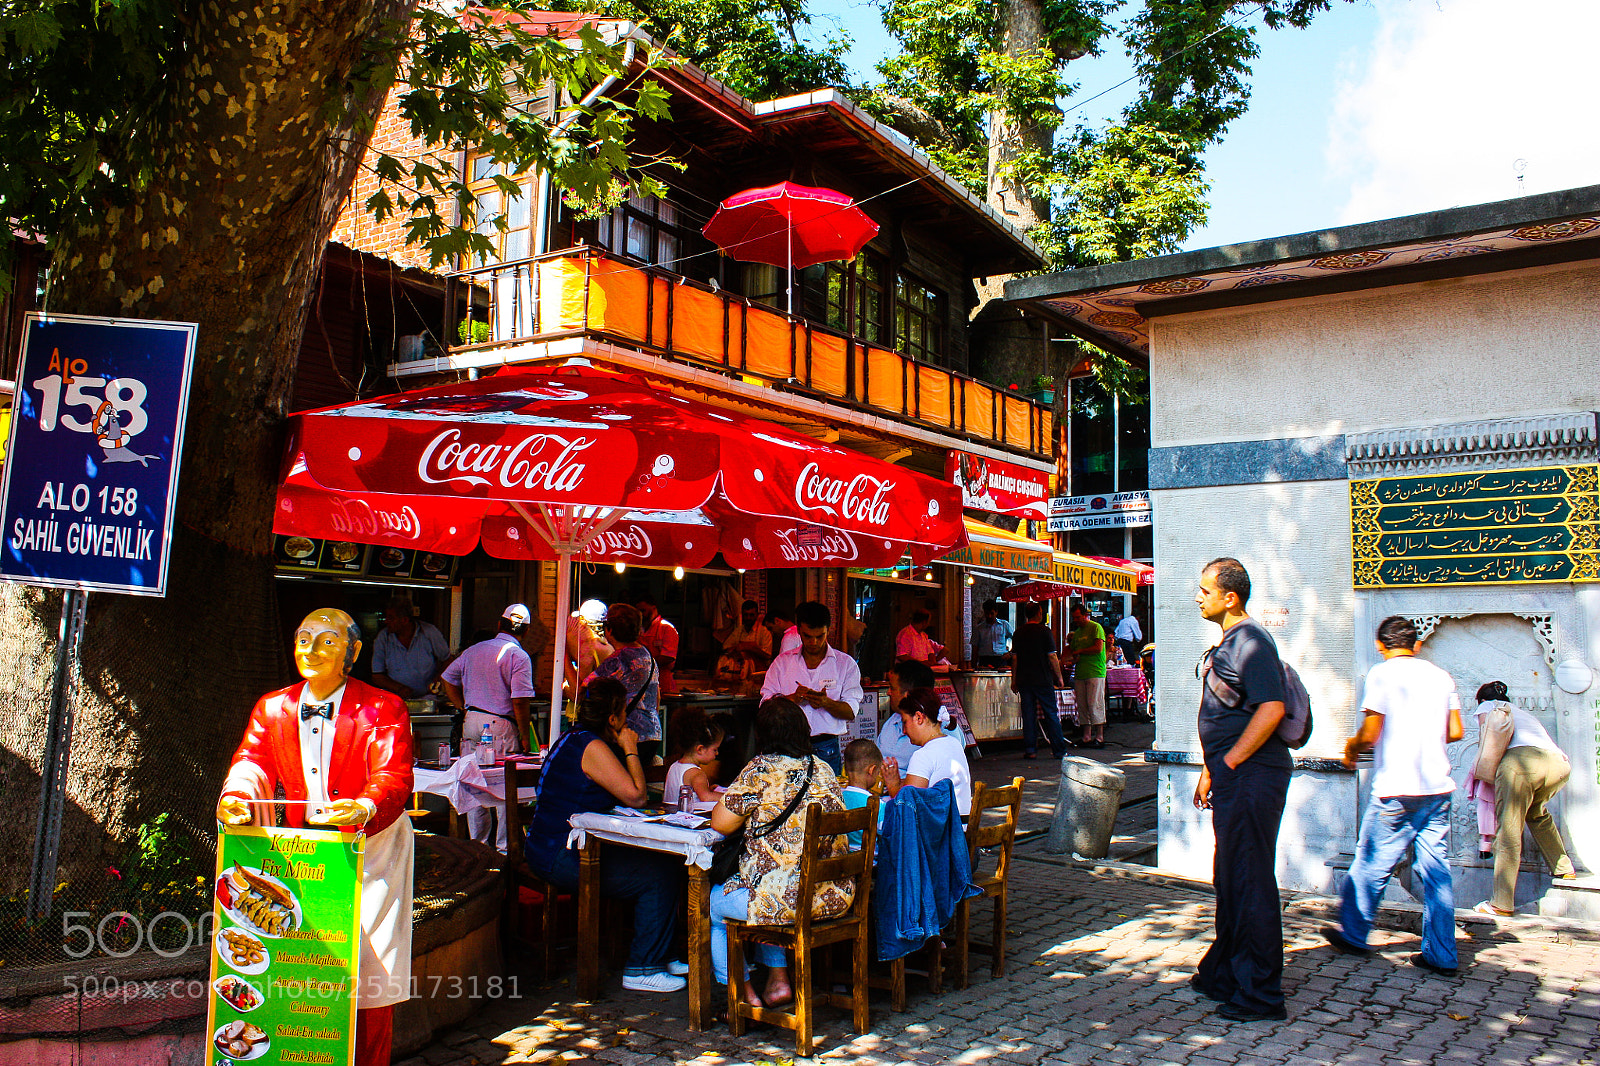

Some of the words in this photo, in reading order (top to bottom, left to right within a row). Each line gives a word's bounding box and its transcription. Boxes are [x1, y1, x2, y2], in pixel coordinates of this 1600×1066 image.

[48, 347, 88, 384] ALO
[33, 375, 149, 438] 158
[418, 428, 597, 492] Coca-Cola
[37, 481, 91, 513] ALO
[98, 485, 138, 517] 158
[795, 462, 896, 526] Coca-Cola
[1052, 497, 1085, 507] EURASIA
[1112, 491, 1149, 502] AVRASYA
[12, 513, 62, 553] SAHİL
[66, 516, 155, 560] GÜVENLİK
[1050, 520, 1080, 529] FATURA
[1082, 517, 1111, 527] ÖDEME
[1037, 563, 1085, 585] LIKCI
[268, 833, 317, 859] Kafkas
[259, 858, 282, 878] Fix
[282, 860, 326, 881] Mönü
